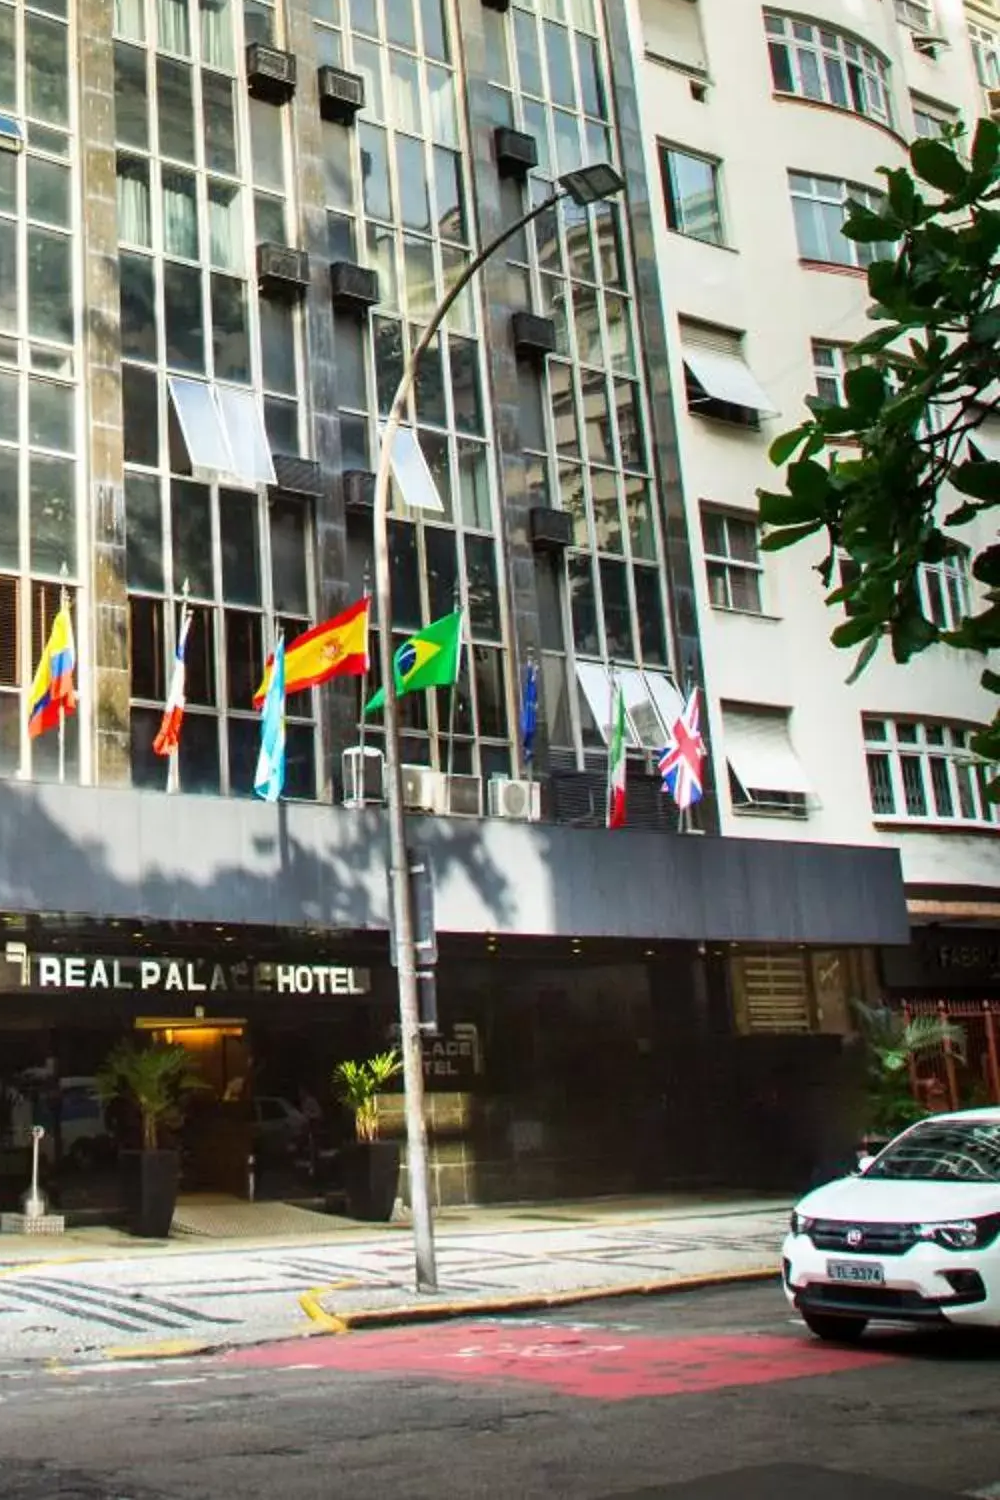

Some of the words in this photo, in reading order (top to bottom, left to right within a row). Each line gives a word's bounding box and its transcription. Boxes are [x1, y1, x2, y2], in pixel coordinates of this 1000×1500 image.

[39, 957, 133, 989] REAL
[140, 960, 273, 992] PALACE
[276, 964, 365, 996] HOTEL
